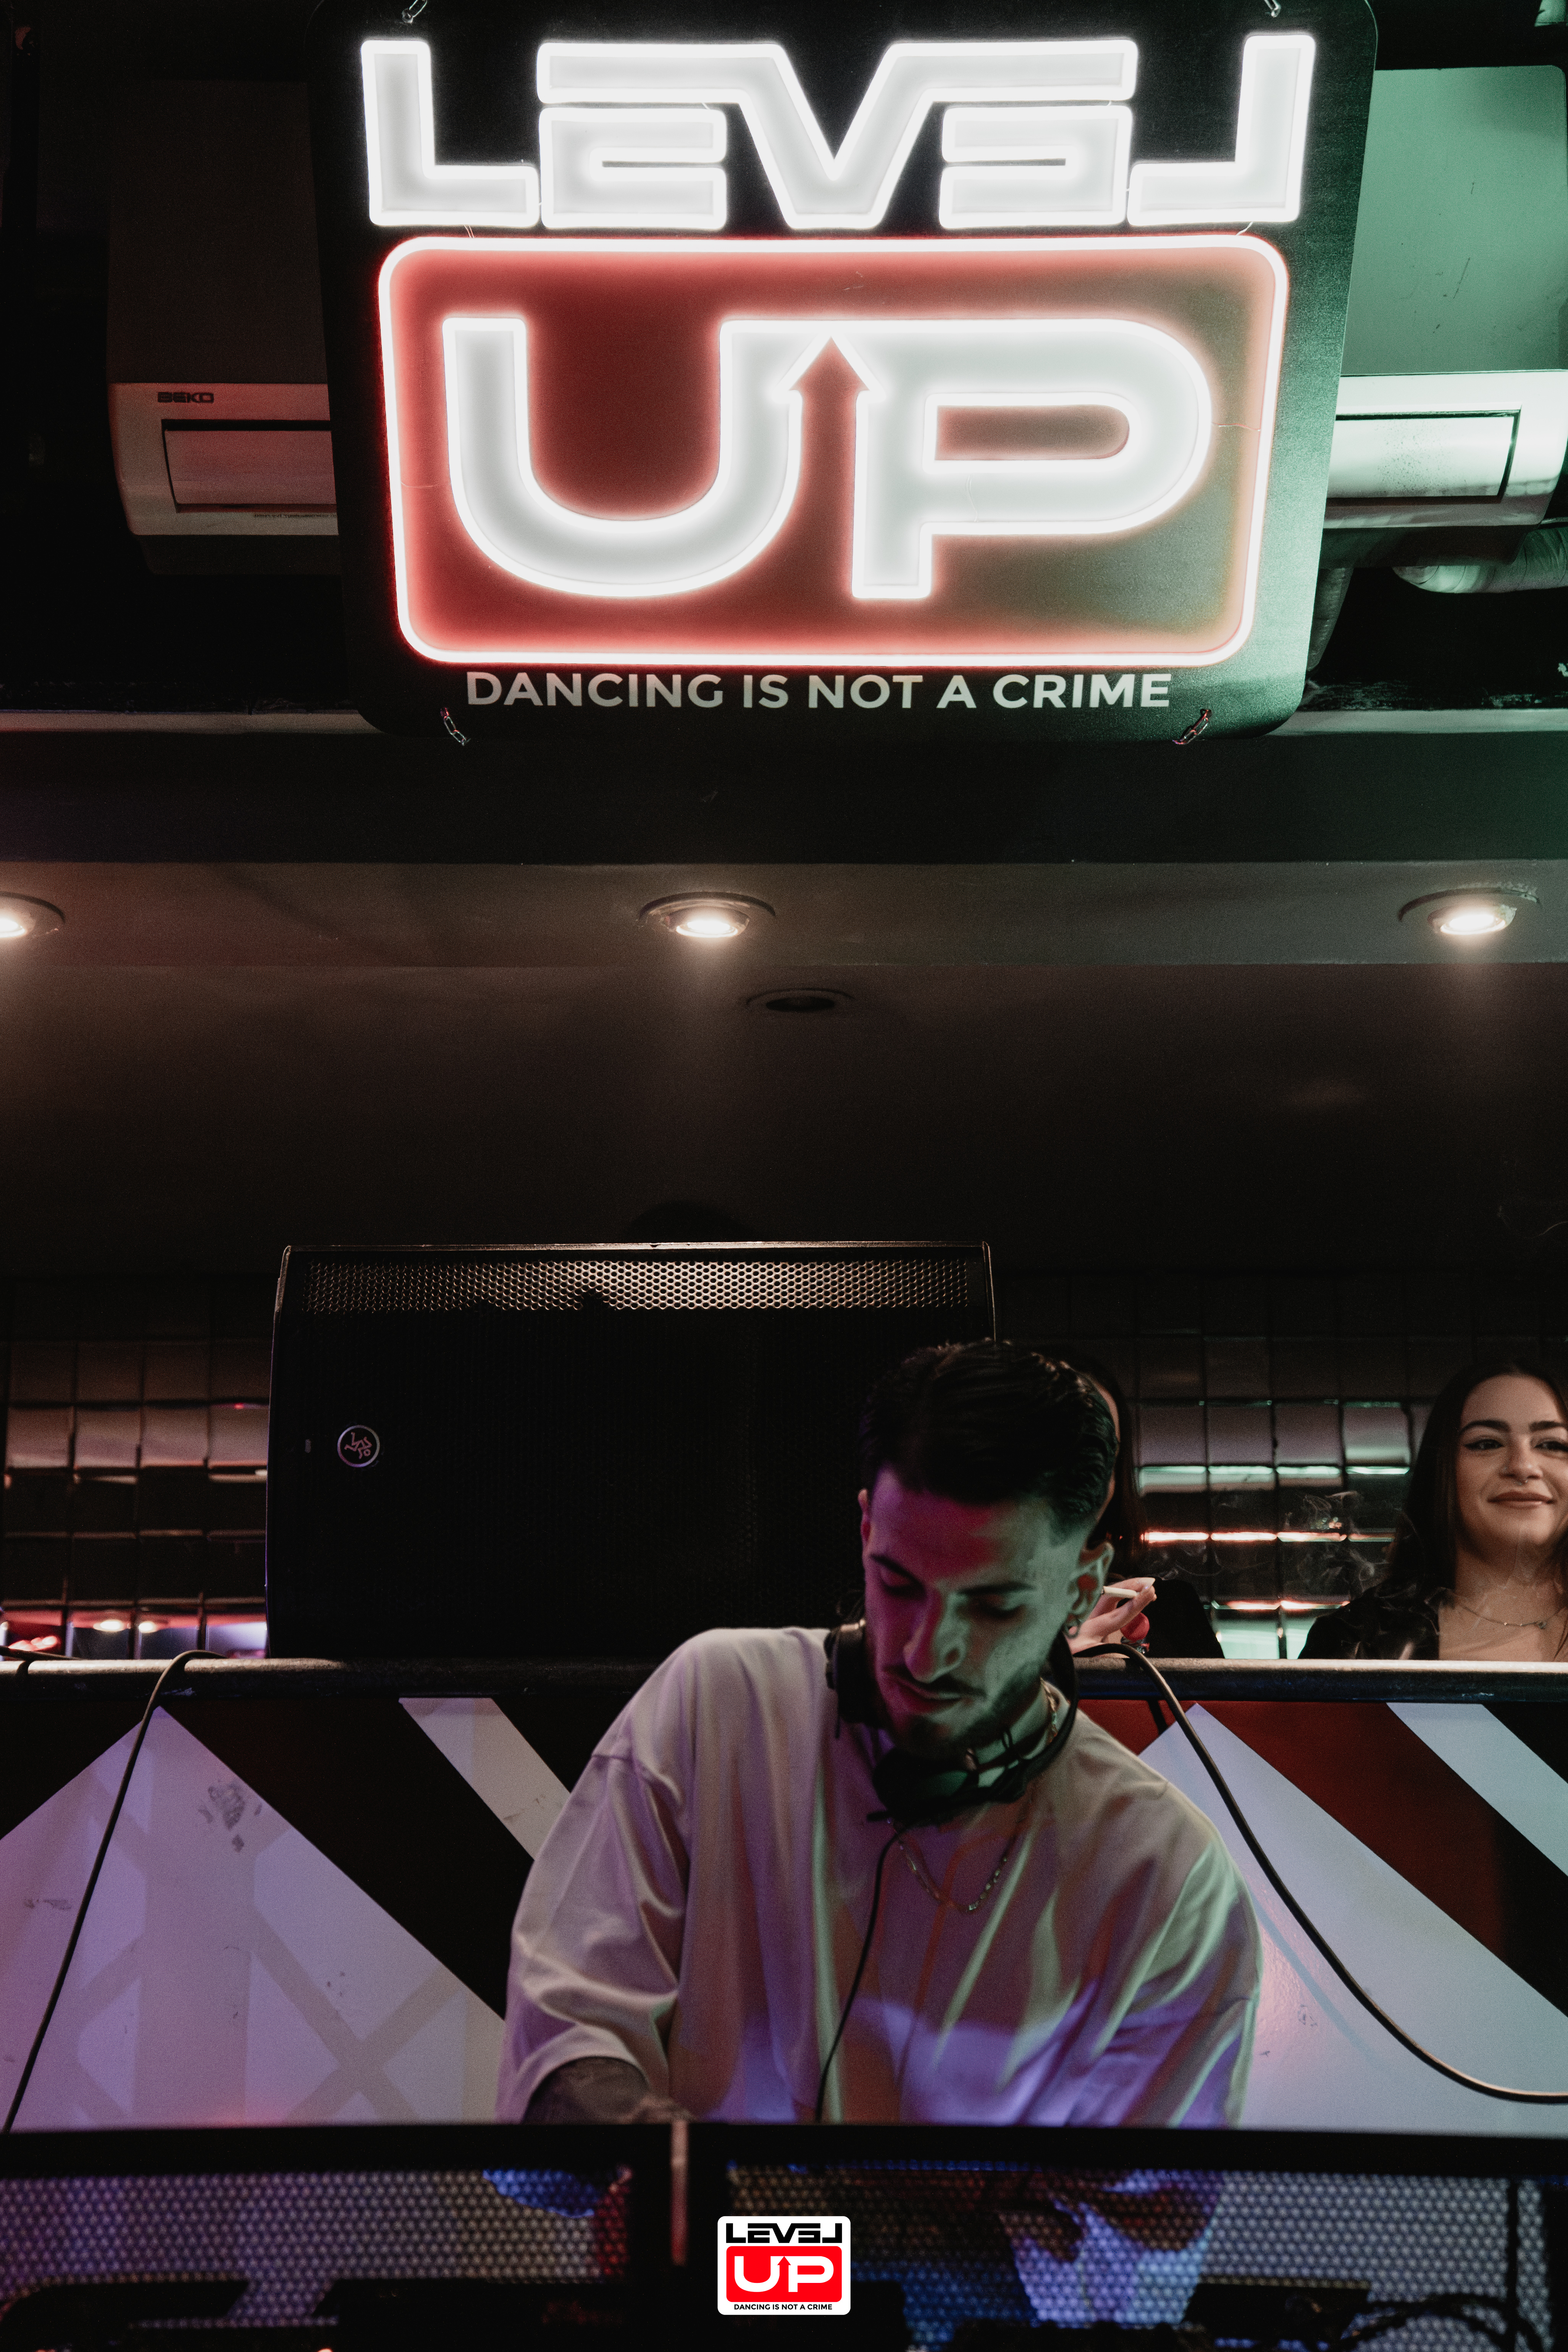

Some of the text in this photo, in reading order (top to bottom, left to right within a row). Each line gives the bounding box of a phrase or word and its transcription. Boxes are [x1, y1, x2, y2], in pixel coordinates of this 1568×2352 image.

[360, 34, 1316, 230] LEVEL
[158, 392, 214, 403] BEKO
[443, 316, 1213, 600] UP
[467, 672, 1172, 708] DANCING IS NOT A CRIME
